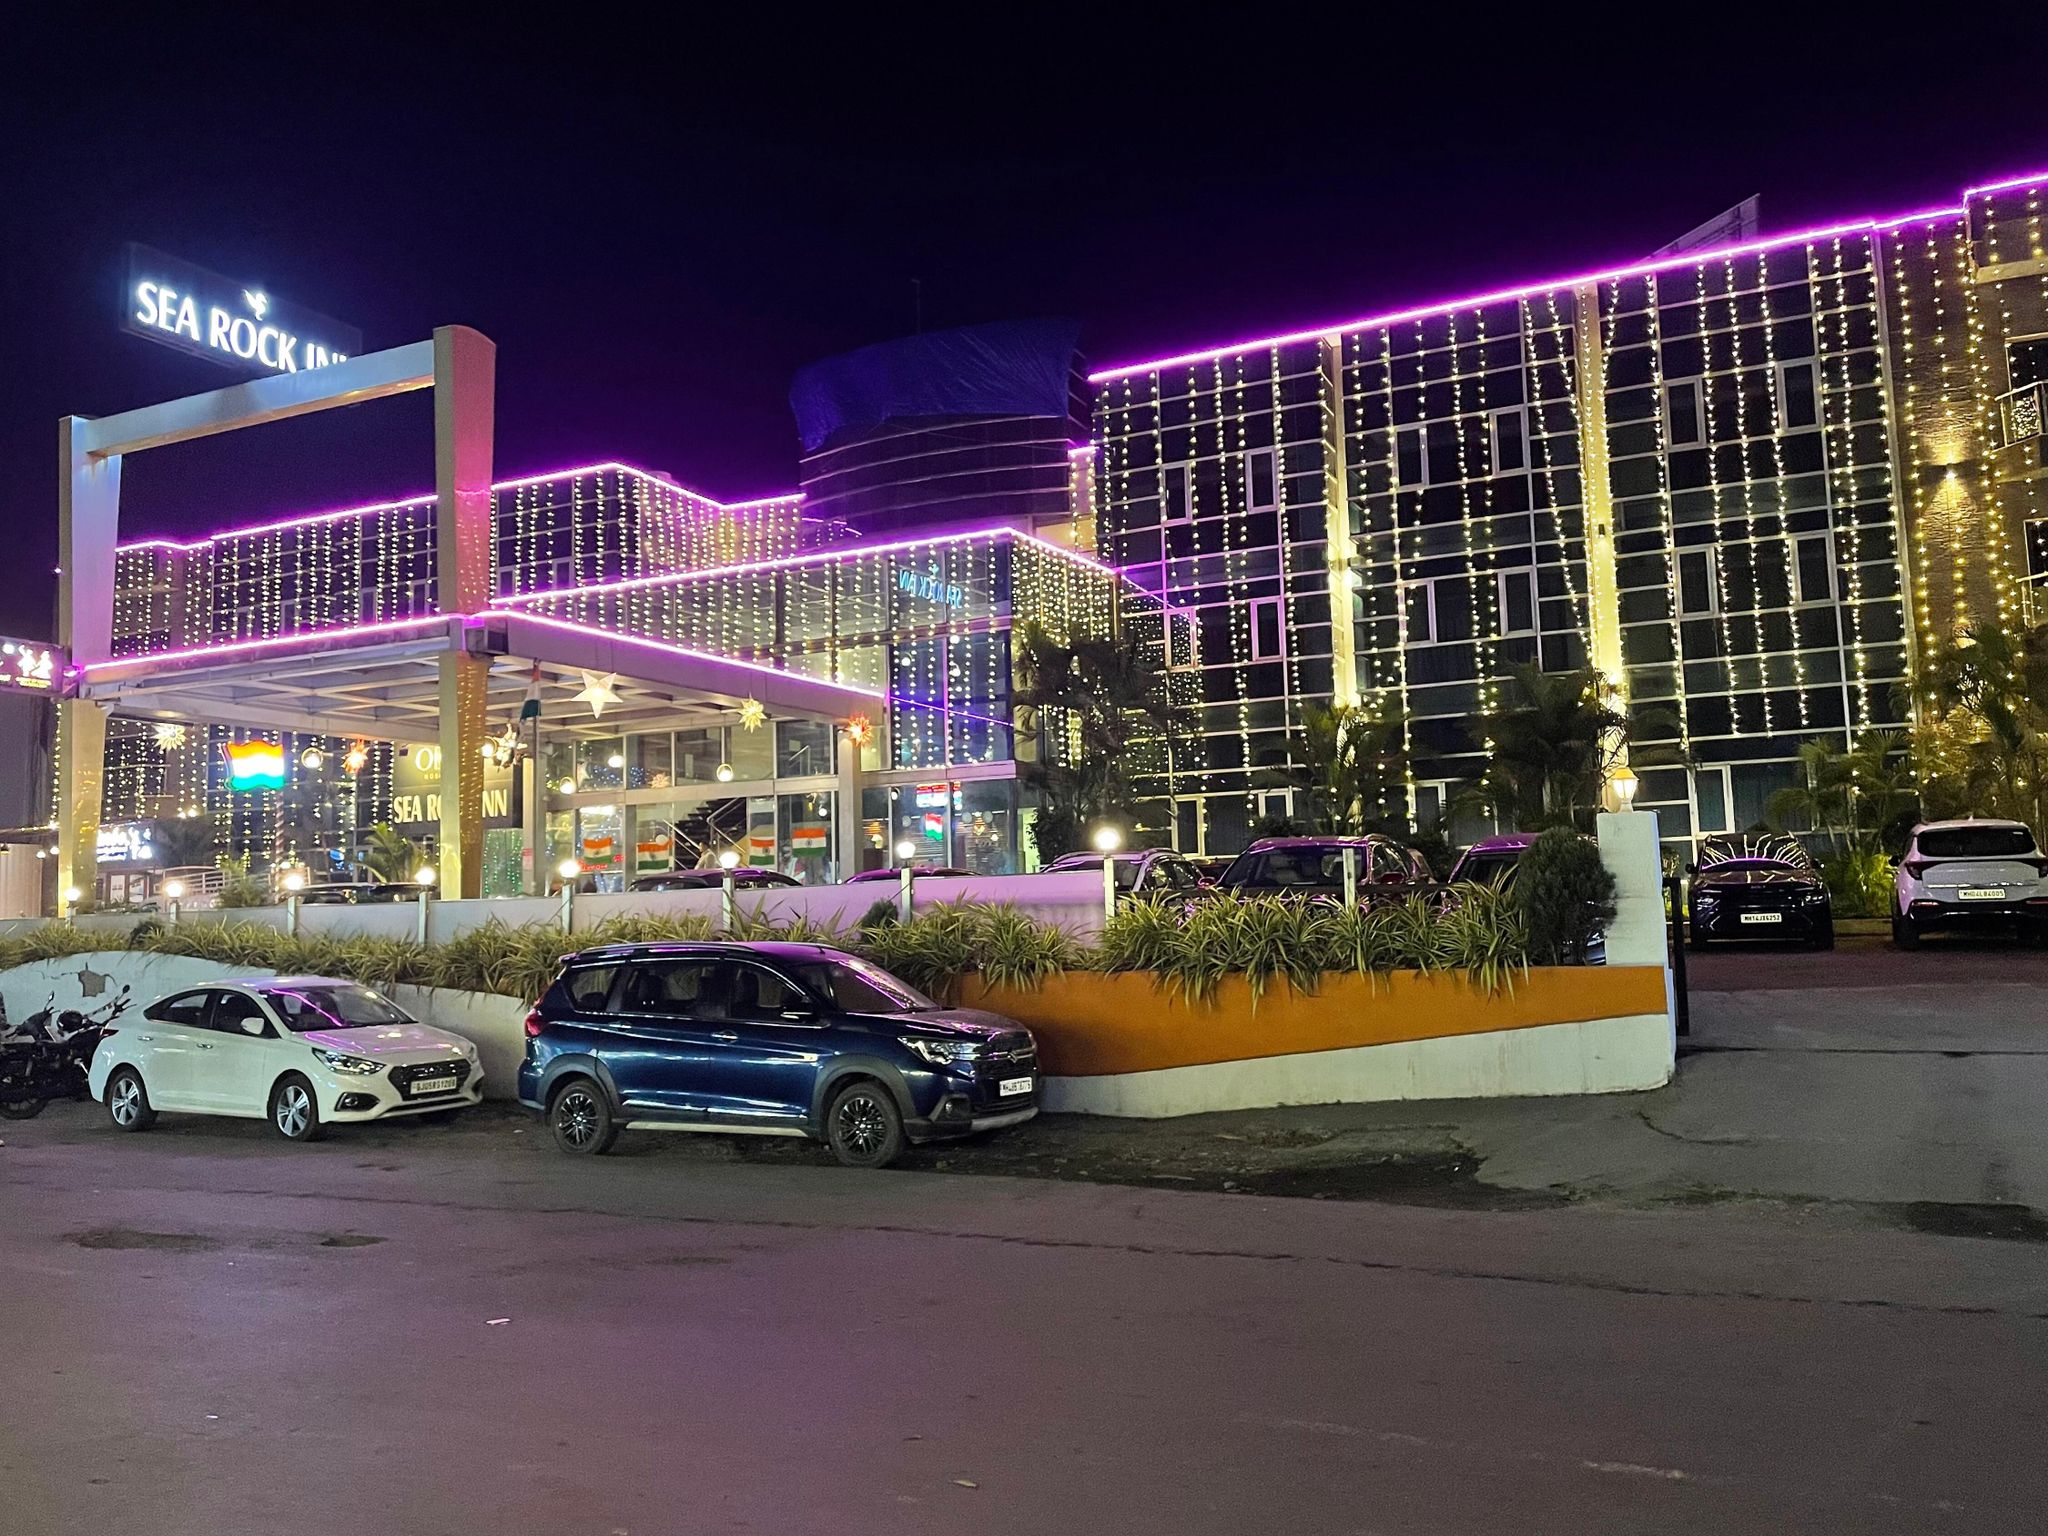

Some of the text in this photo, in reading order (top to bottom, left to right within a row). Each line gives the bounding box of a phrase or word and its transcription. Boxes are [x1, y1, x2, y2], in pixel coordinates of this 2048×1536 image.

[137, 281, 200, 342] SEA
[210, 307, 298, 374] ROCK
[393, 794, 423, 824] SEA
[481, 788, 508, 818] NN
